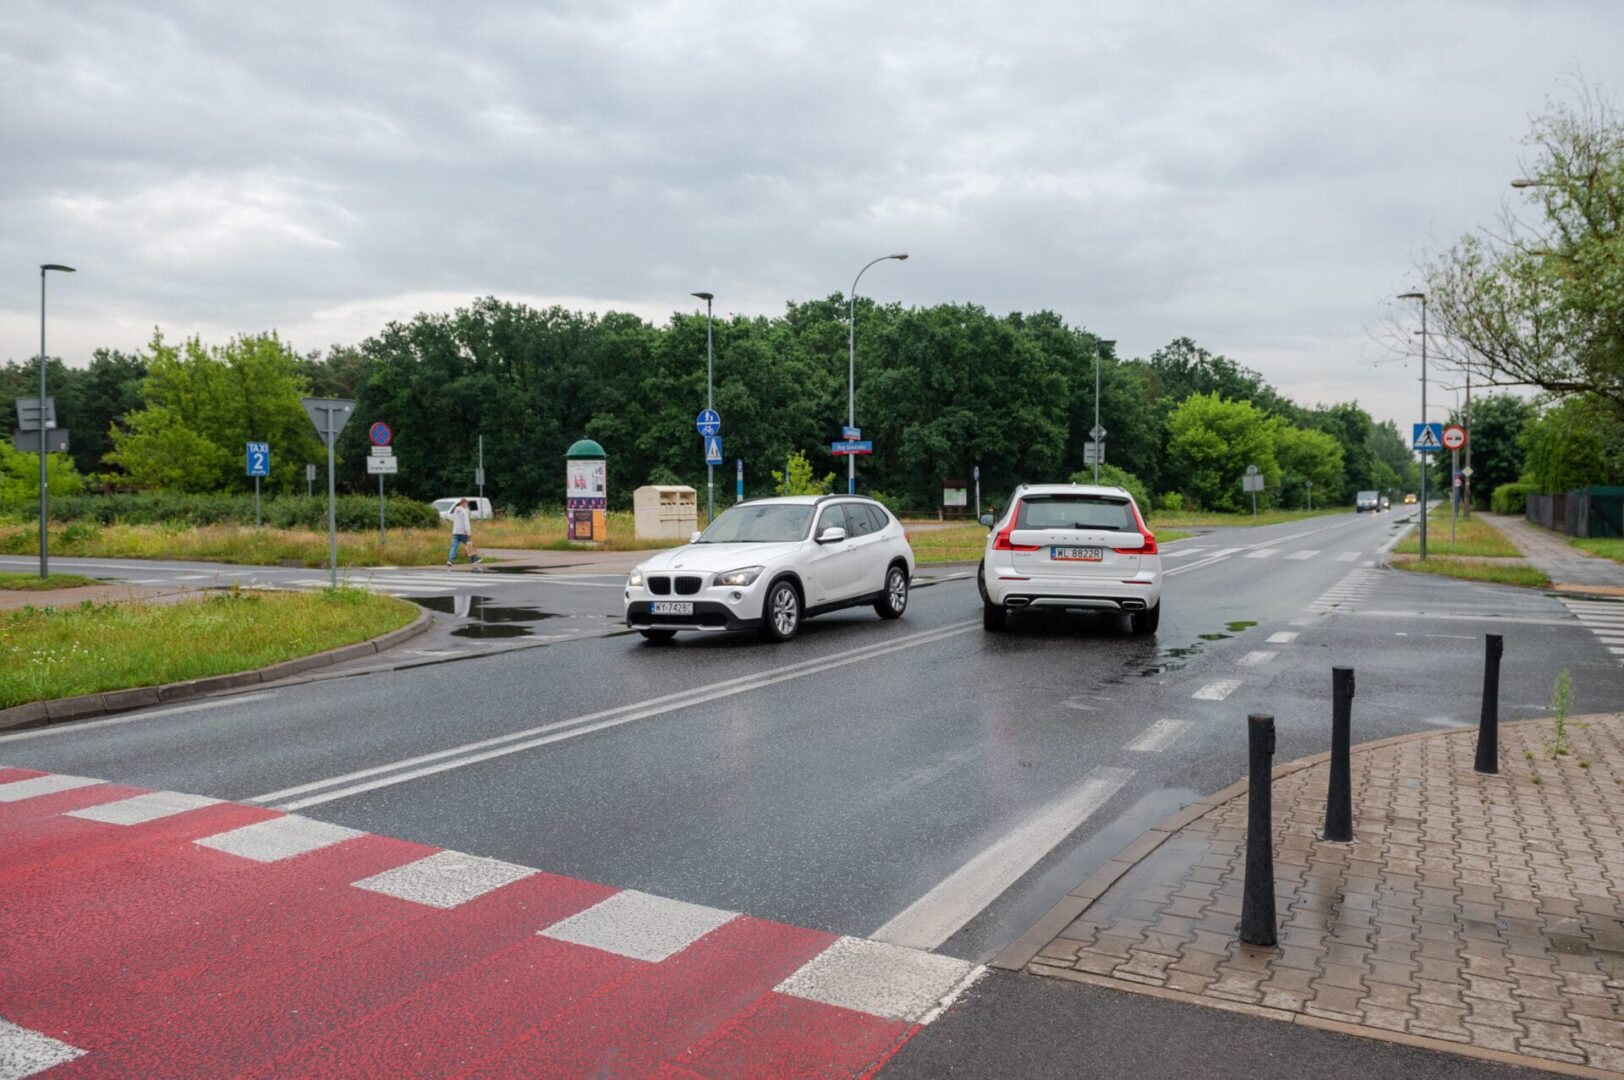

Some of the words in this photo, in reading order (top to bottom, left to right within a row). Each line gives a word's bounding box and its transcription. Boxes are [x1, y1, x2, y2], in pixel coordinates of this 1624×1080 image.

[248, 443, 269, 452] TAXI
[253, 453, 264, 469] 2
[1057, 548, 1069, 558] WL
[1072, 548, 1100, 558] 8822R
